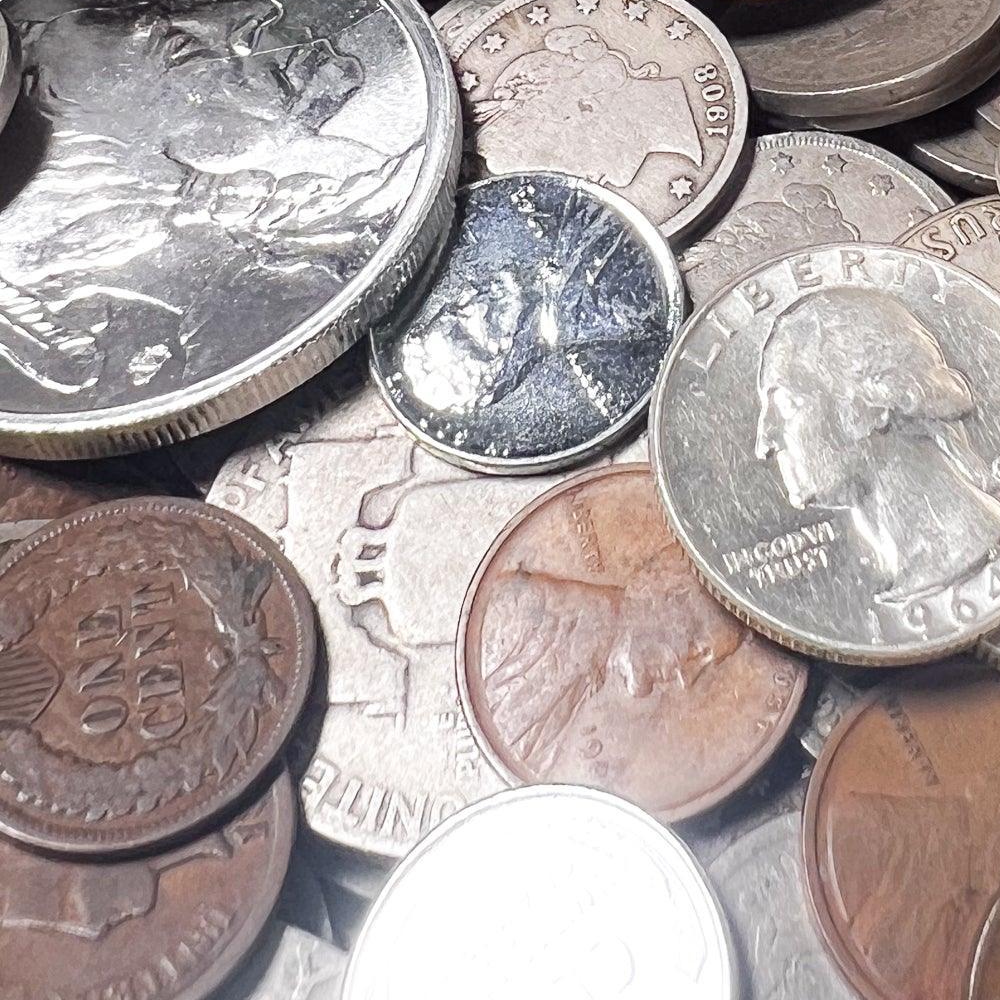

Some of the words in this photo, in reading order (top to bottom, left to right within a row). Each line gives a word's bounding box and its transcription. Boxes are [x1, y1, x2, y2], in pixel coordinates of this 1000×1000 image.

[692, 62, 732, 138] 1908
[680, 249, 949, 372] LIBERTY
[77, 603, 130, 737] ONE
[131, 580, 188, 741] CENT
[301, 756, 466, 840] UNITE
